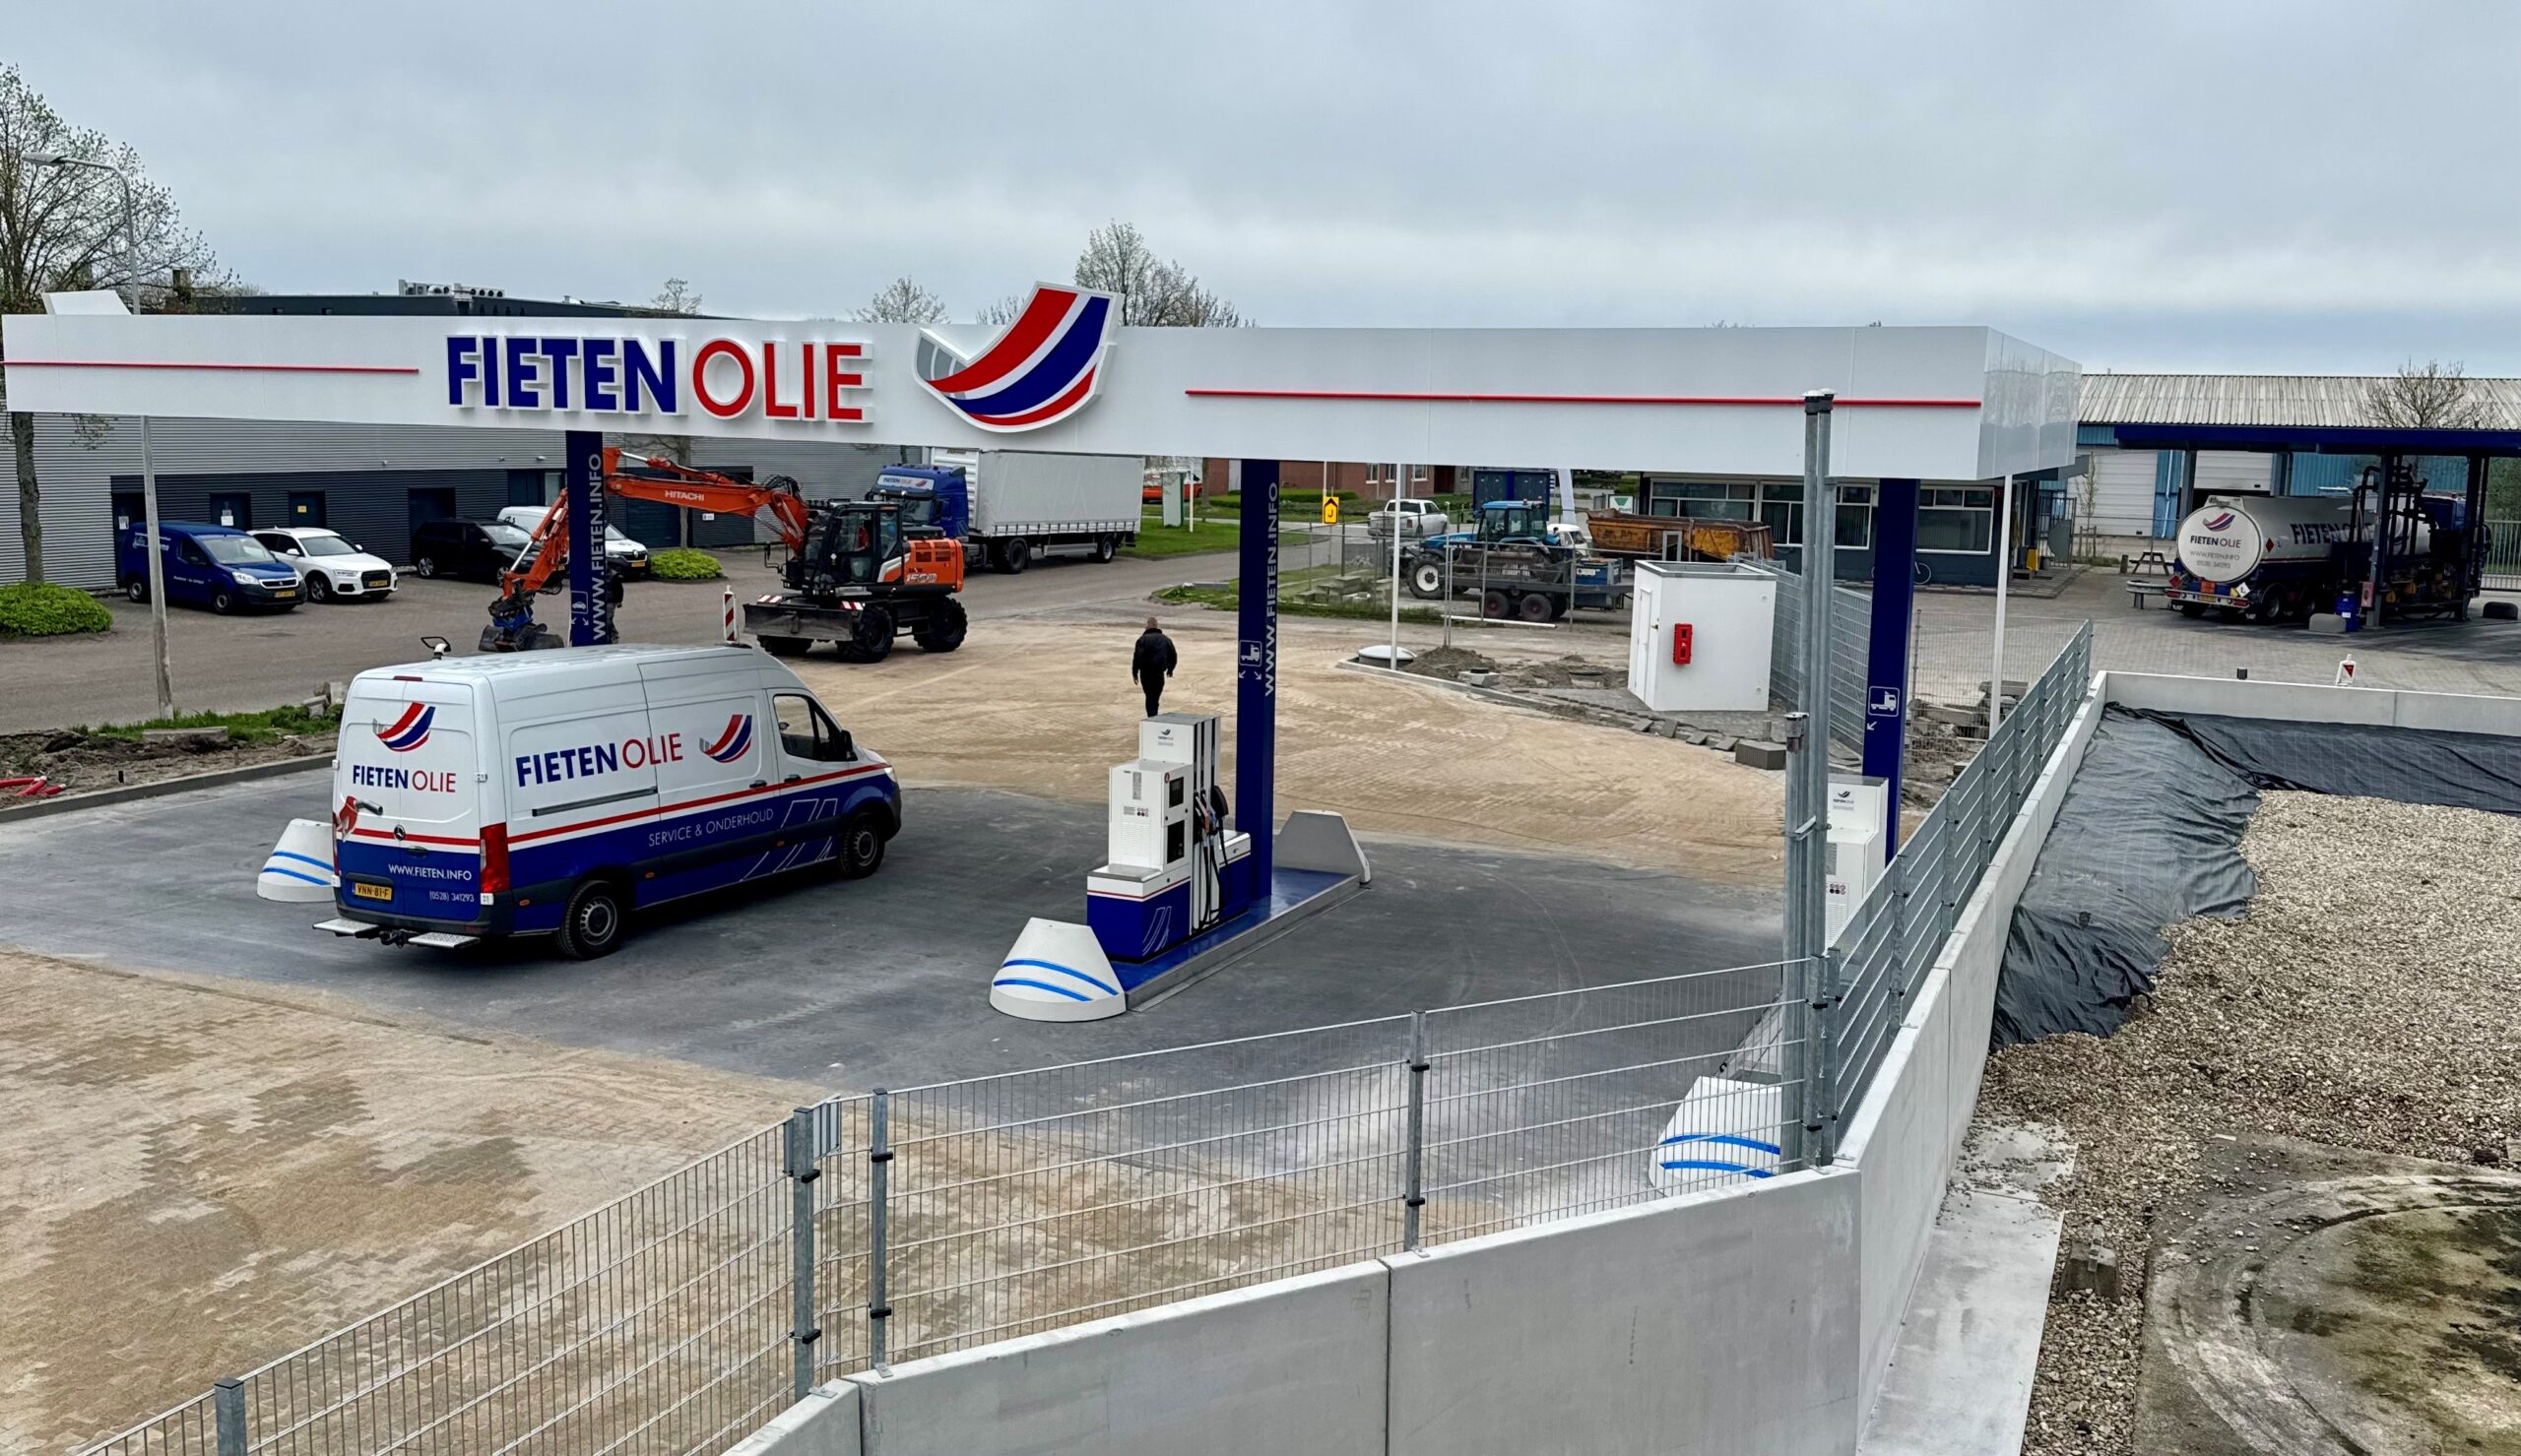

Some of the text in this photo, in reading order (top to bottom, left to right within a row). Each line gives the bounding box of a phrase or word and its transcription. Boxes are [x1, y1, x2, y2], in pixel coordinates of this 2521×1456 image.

[446, 335, 867, 421] FIETEN OLIE
[665, 490, 705, 502] HITACHI
[588, 453, 607, 641] WWW.FIETEN.INFO
[2190, 535, 2242, 548] FIETEN OLIE
[1264, 481, 1278, 697] WWW.FIETEN.INFO
[515, 732, 683, 788] FIETEN OLIE
[353, 764, 456, 792] FIETEN OLIE
[648, 808, 774, 847] SERVICE & ONDERHOUD
[388, 863, 472, 881] WWW.FIETEN.INFO
[356, 884, 389, 898] VNN-81-F
[429, 890, 475, 903] (0528) 341293
